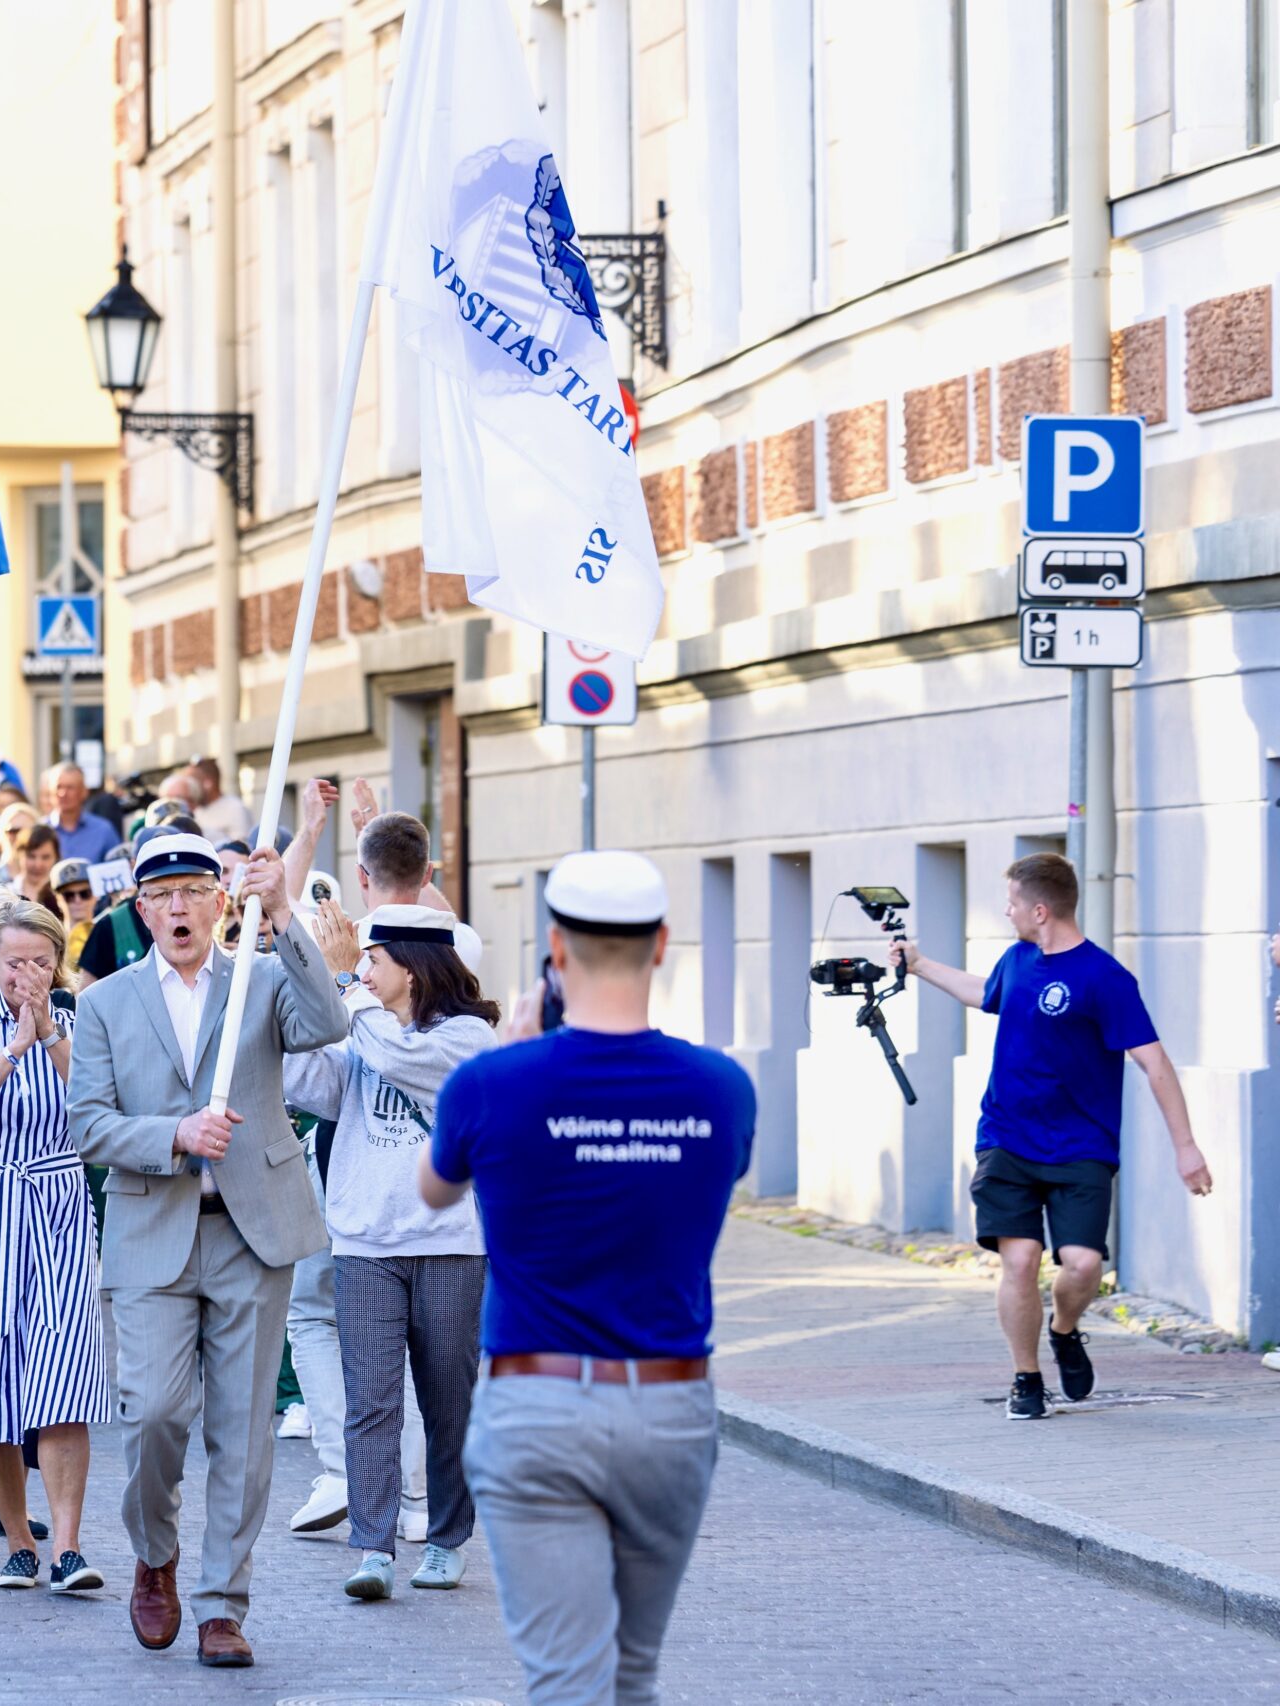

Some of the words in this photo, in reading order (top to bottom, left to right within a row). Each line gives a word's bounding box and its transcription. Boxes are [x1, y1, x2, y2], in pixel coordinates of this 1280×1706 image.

[1053, 430, 1115, 522] P
[1035, 636, 1051, 659] P
[1074, 629, 1081, 646] 1
[1089, 629, 1099, 646] h
[384, 1125, 408, 1137] 1632
[546, 1115, 624, 1139] Võime
[628, 1115, 712, 1138] muuta
[407, 1132, 426, 1146] OF
[575, 1140, 682, 1162] maailma
